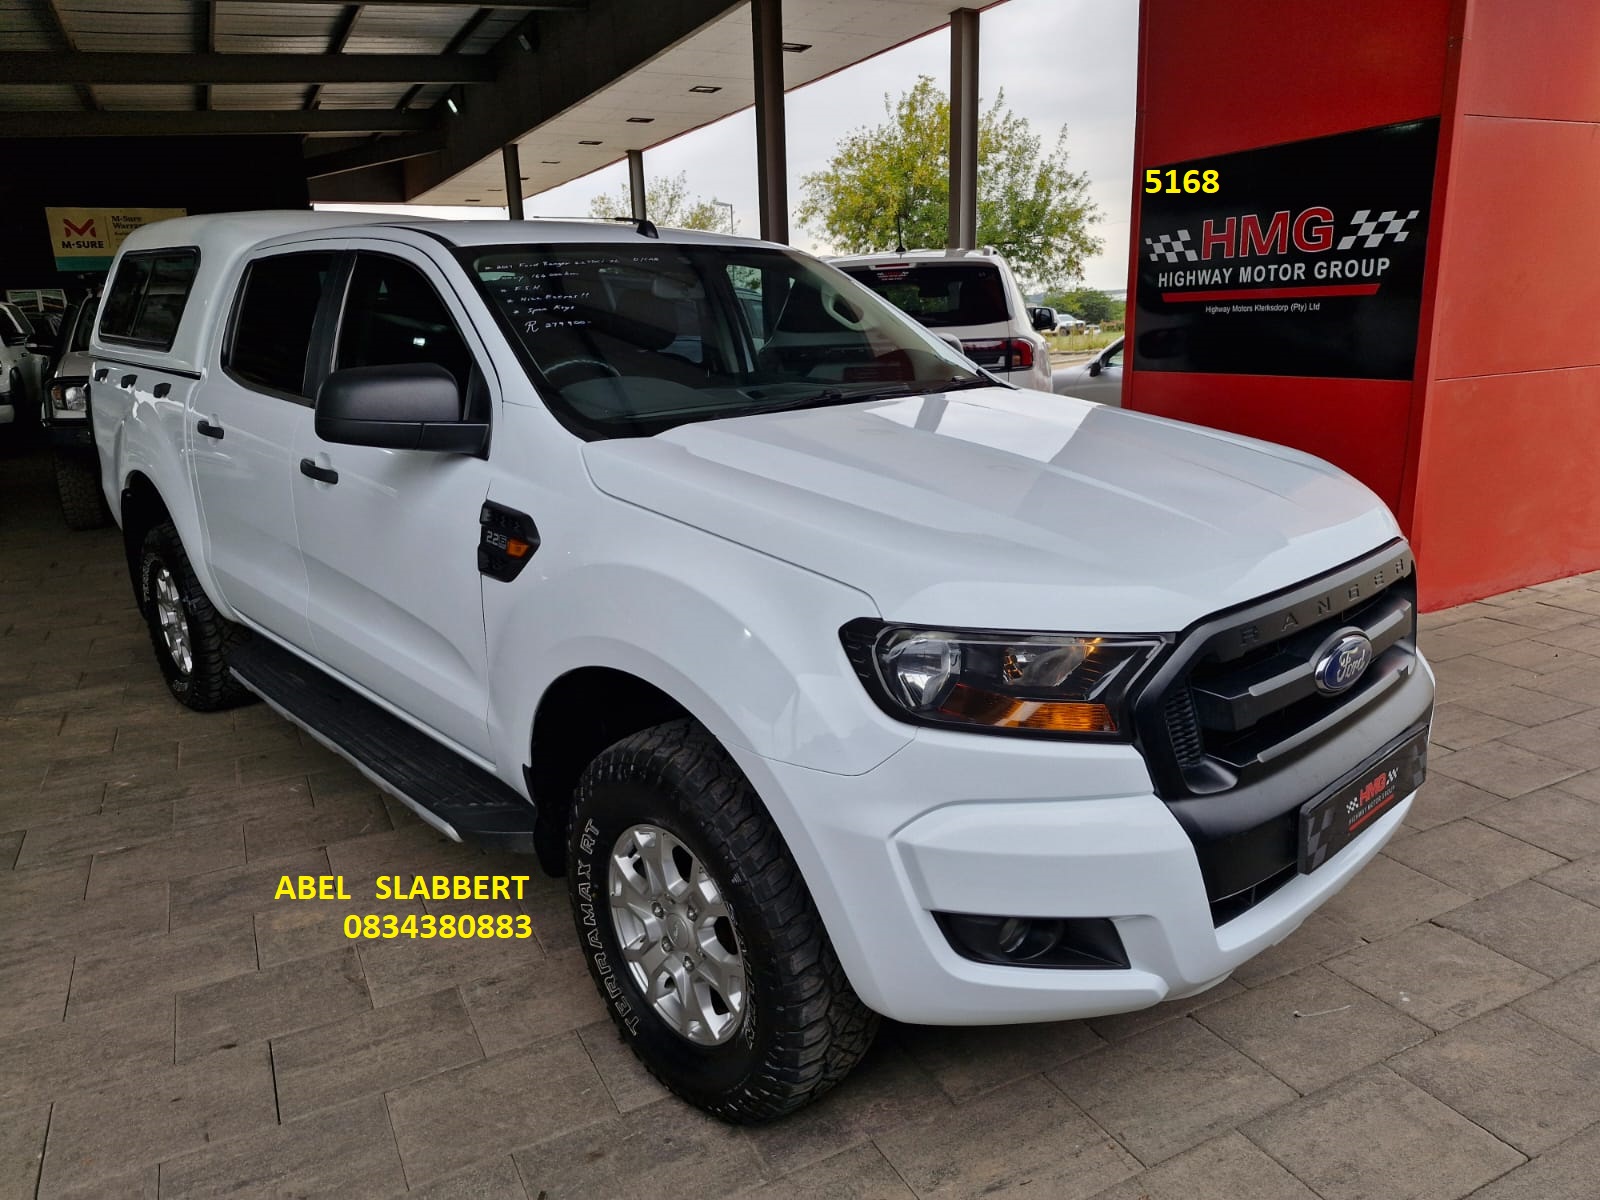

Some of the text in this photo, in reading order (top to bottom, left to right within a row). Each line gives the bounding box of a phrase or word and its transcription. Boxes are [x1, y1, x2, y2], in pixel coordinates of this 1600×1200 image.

[1201, 206, 1335, 260] HMG
[1158, 257, 1390, 288] HIGHWAY MOTOR GROUP
[1205, 302, 1320, 314] Highway Motors Klerksdorp (Pty) Ltd
[1336, 647, 1366, 682] Ford
[1360, 772, 1387, 806] HMG
[577, 818, 641, 1037] TERRAMAX RT
